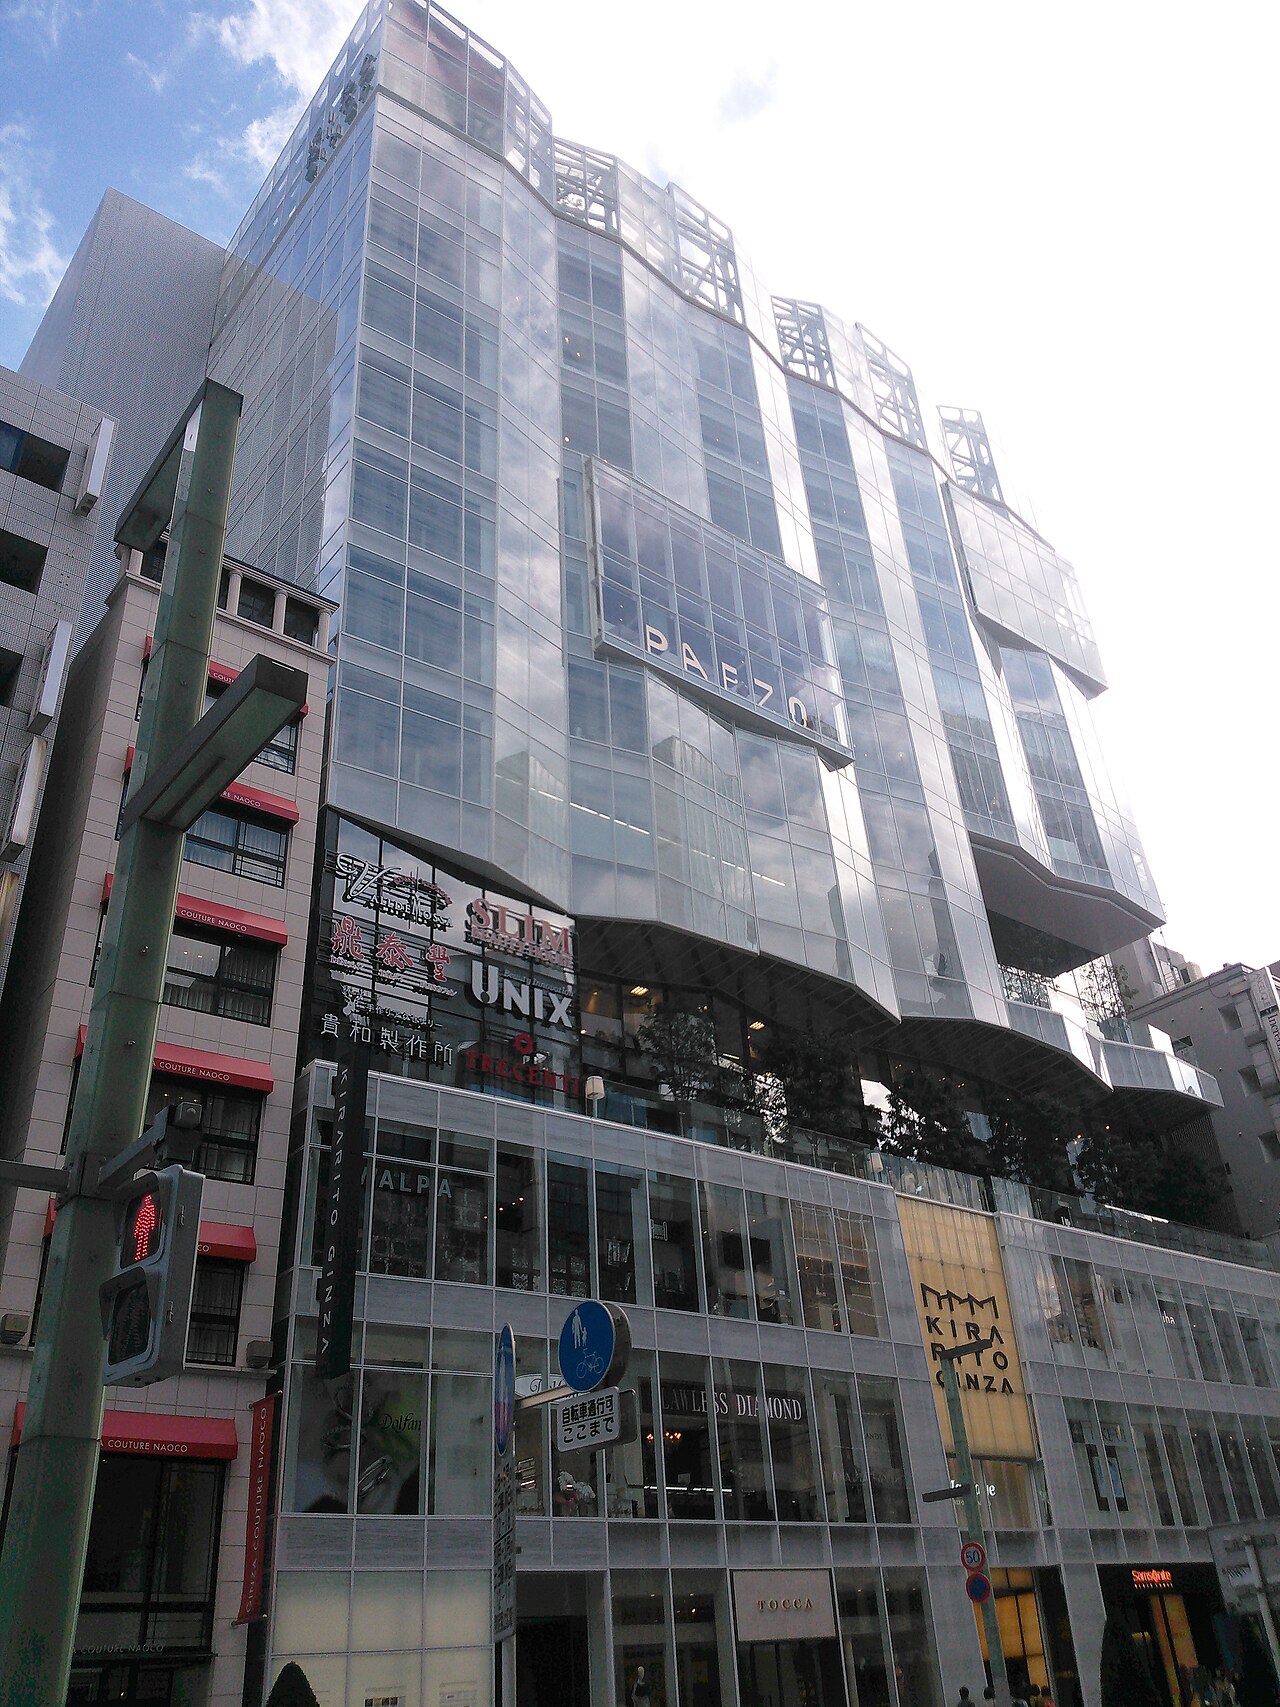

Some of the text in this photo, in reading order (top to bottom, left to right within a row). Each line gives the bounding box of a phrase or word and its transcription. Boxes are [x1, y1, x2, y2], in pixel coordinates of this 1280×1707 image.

[233, 794, 261, 807] NAOCO
[180, 909, 247, 932] COUTURE NAOCO
[471, 898, 569, 955] SLIM
[471, 960, 574, 1028] UNIX
[320, 1013, 453, 1065] 貴和製作所
[160, 1061, 230, 1081] COUTURE NAOCO
[926, 1315, 1004, 1345] KIRA
[562, 1394, 614, 1424] 自転車通行可
[736, 1394, 802, 1421] DIAMOND
[563, 1417, 614, 1443] ここまで
[108, 1440, 188, 1453] COUTURE NAOCO
[965, 1550, 980, 1564] 50
[756, 1598, 812, 1611] TOCCA
[128, 1643, 164, 1653] NAOCO
